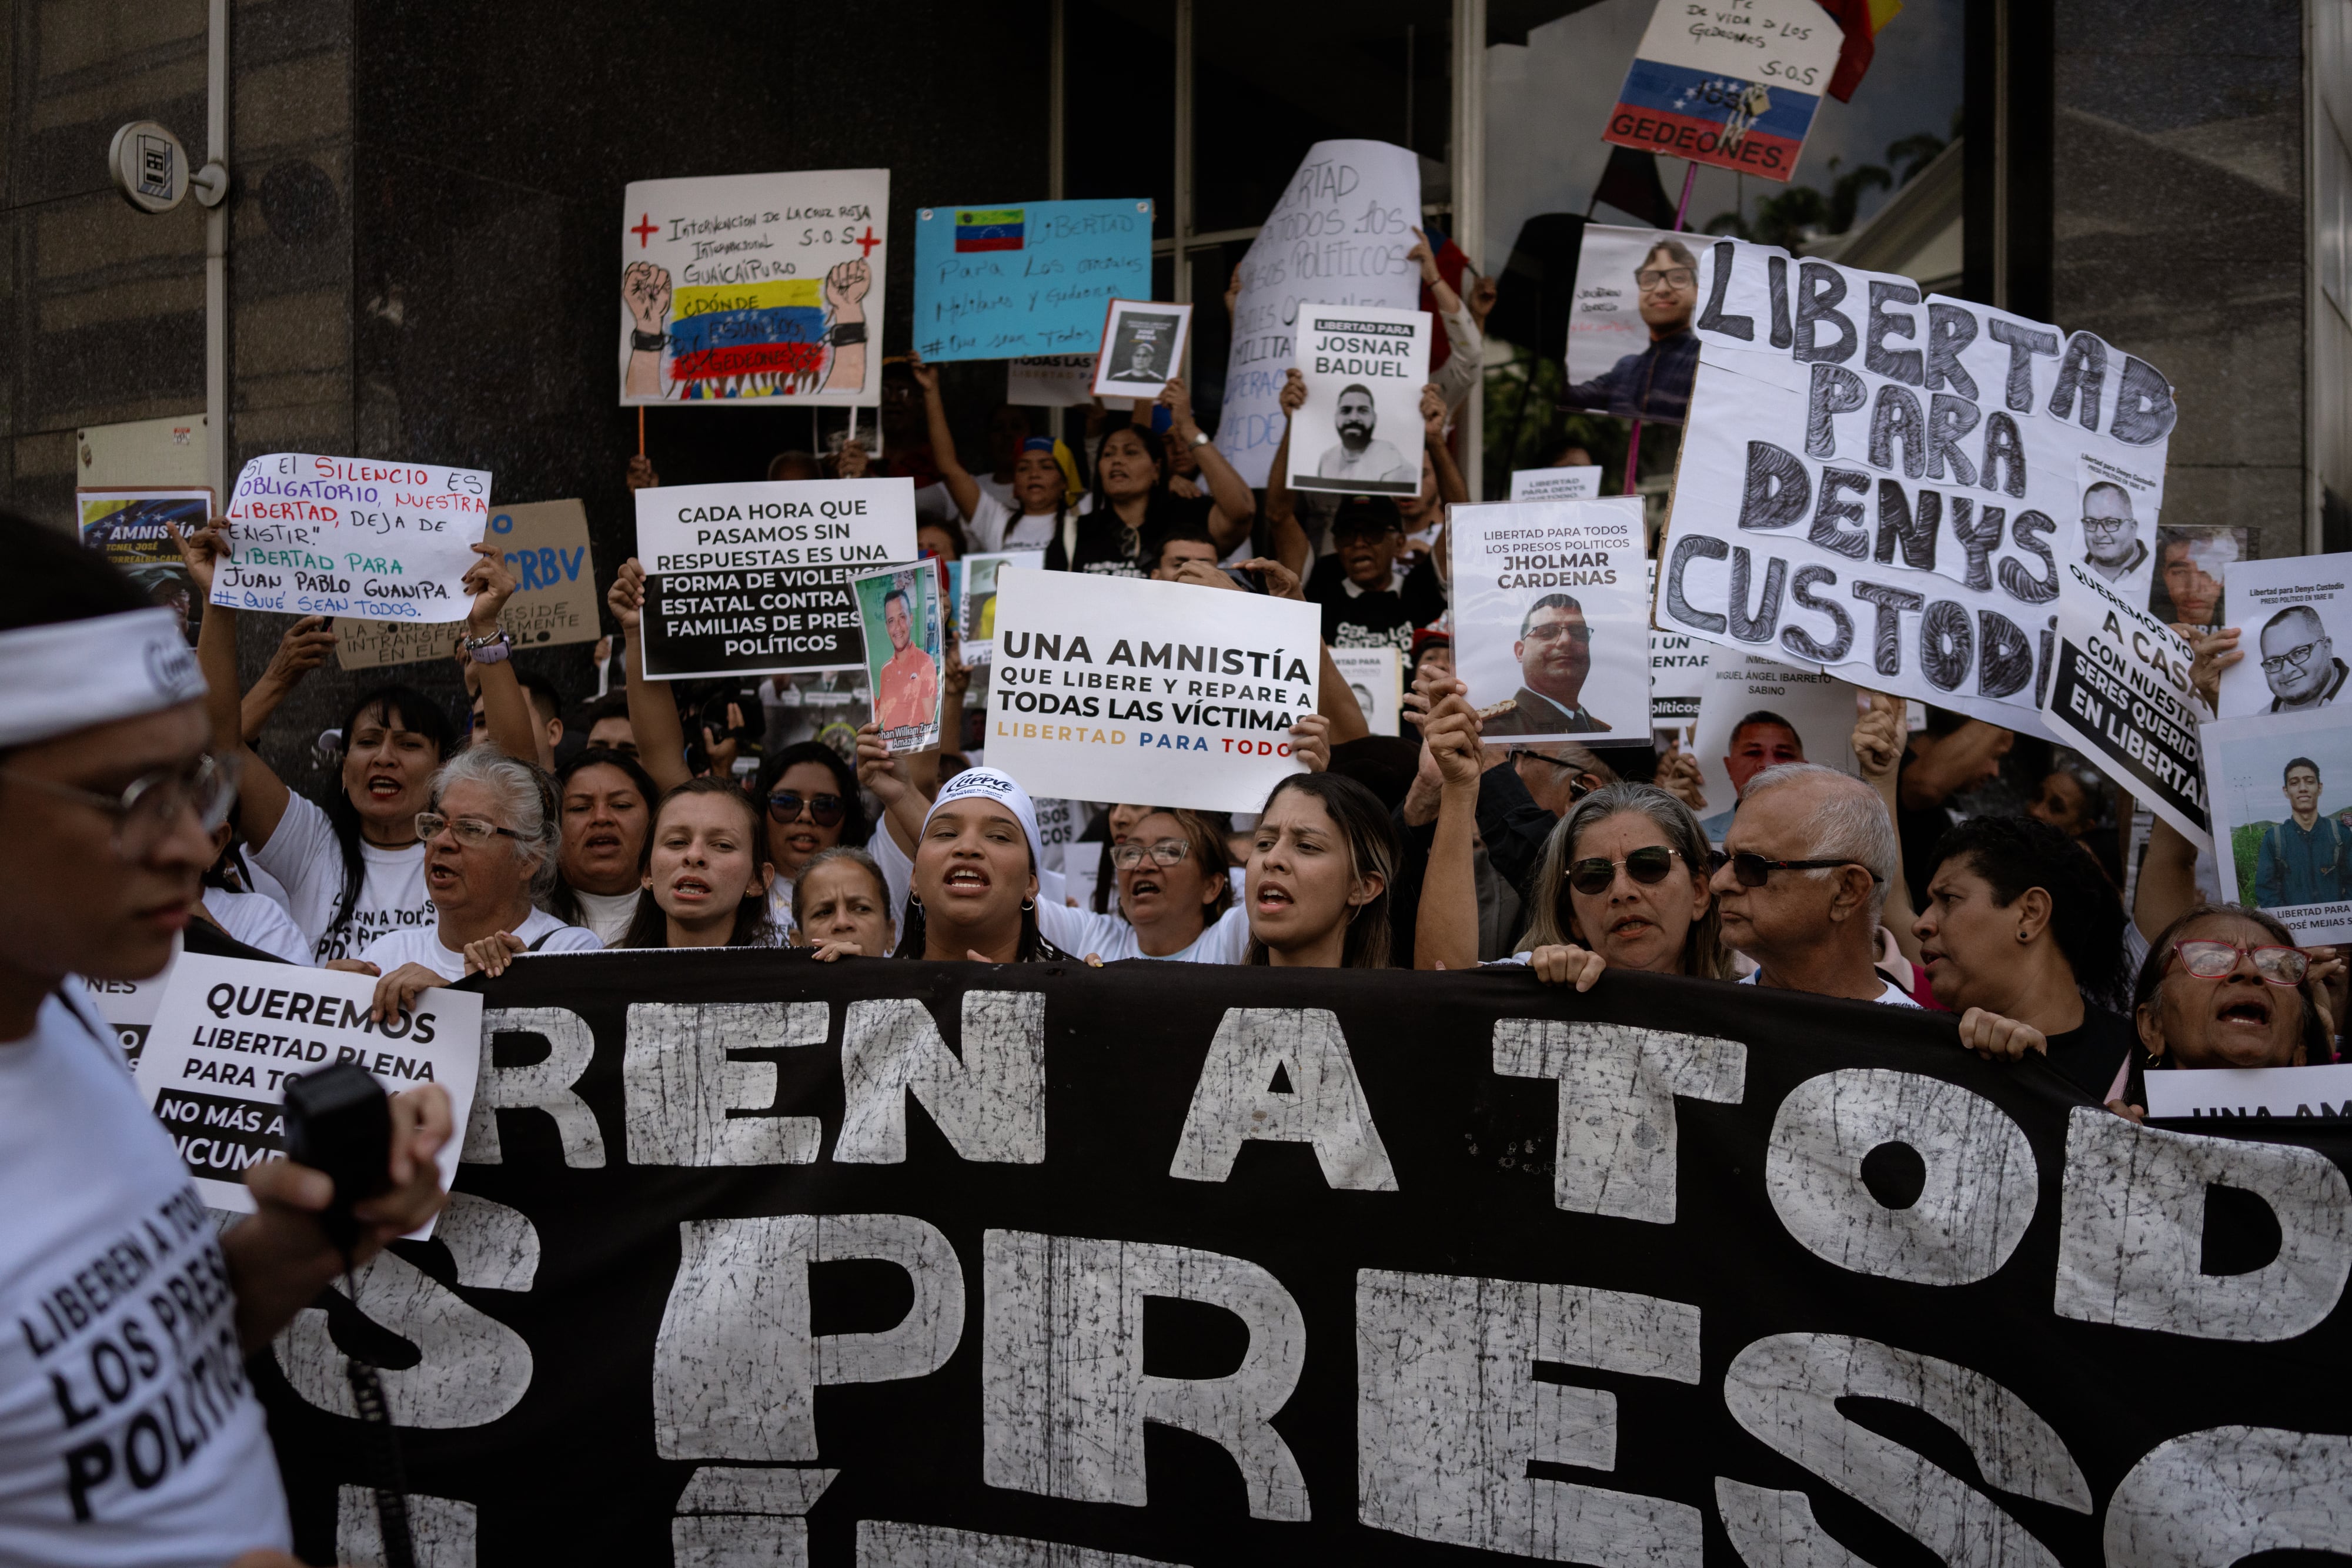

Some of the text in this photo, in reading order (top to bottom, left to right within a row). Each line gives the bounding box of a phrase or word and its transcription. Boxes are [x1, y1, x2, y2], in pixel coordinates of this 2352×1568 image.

[1317, 320, 1411, 336] LIBERTAD PARA
[1317, 336, 1410, 357] JOSNAR
[1697, 241, 2177, 445] LIBERTAD
[1315, 357, 1409, 378] BADUEL
[1805, 363, 2026, 498] PARA
[315, 457, 427, 485] SILENCIO
[447, 472, 483, 494] ES
[1530, 478, 1579, 487] LIBERTAD
[240, 477, 487, 514] OBLIGATORIO, NUESTRA
[1522, 485, 1585, 496] PARA DENYS
[231, 500, 446, 534] LIBERTAD, DEJA DE
[678, 499, 867, 524] CADA HORA QUE
[1739, 440, 2060, 604] DENYS
[109, 522, 195, 540] AMNISÍA
[697, 523, 850, 546] PASAMOS SIN
[1484, 525, 1628, 541] LIBERTAD PARA TODOS
[231, 543, 403, 575] LIBERTAD PARA
[657, 544, 888, 571] RESPUESTAS ES UNA
[1486, 538, 1630, 554] LOS PRESOS POLITICOS
[1503, 551, 1609, 571] JHOLMAR
[223, 566, 450, 600] JUAN PABLO GUANIPA.
[662, 572, 741, 594] FORMA
[746, 571, 776, 589] DE
[1498, 569, 1617, 589] CARDENAS
[2250, 588, 2277, 596] Libertad
[298, 596, 421, 617] SEAN TODOS.
[662, 590, 850, 616] ESTATAL CONTRA
[2069, 563, 2167, 643] QUEREMOS
[344, 624, 367, 639] LA
[666, 610, 861, 637] FAMILIAS DE PRES
[2102, 609, 2124, 644] A
[379, 643, 442, 663] EN EL
[724, 634, 837, 656] POLÍTICOS
[1004, 630, 1093, 664] UNA
[1107, 638, 1311, 686] AMNISTÍA
[1001, 666, 1312, 708] QUE LIBERE Y REPARE A
[1716, 670, 1743, 680] MIGUEL
[1746, 669, 1778, 682] ÁNGEL
[2087, 636, 2197, 733] CON NUESTR
[1748, 686, 1785, 696] SABINO
[997, 690, 1100, 718] TODAS
[1108, 698, 1163, 722] LAS
[2074, 654, 2197, 762] SERES QUERID
[877, 728, 895, 740] ohan
[895, 726, 919, 737] William
[998, 721, 1292, 758] LIBERTAD PARA TODO
[2070, 686, 2205, 812] EN LIBERTA
[2277, 904, 2350, 918] LIBERTAD PARA
[2310, 918, 2344, 928] MEJIAS
[206, 982, 437, 1044] QUEREMOS
[192, 1025, 328, 1064] LIBERTAD
[183, 1058, 256, 1088] PARA
[1170, 1008, 1399, 1192] A
[159, 1098, 201, 1124] NO
[204, 1104, 263, 1133] MÁS
[49, 1318, 160, 1429] LOS
